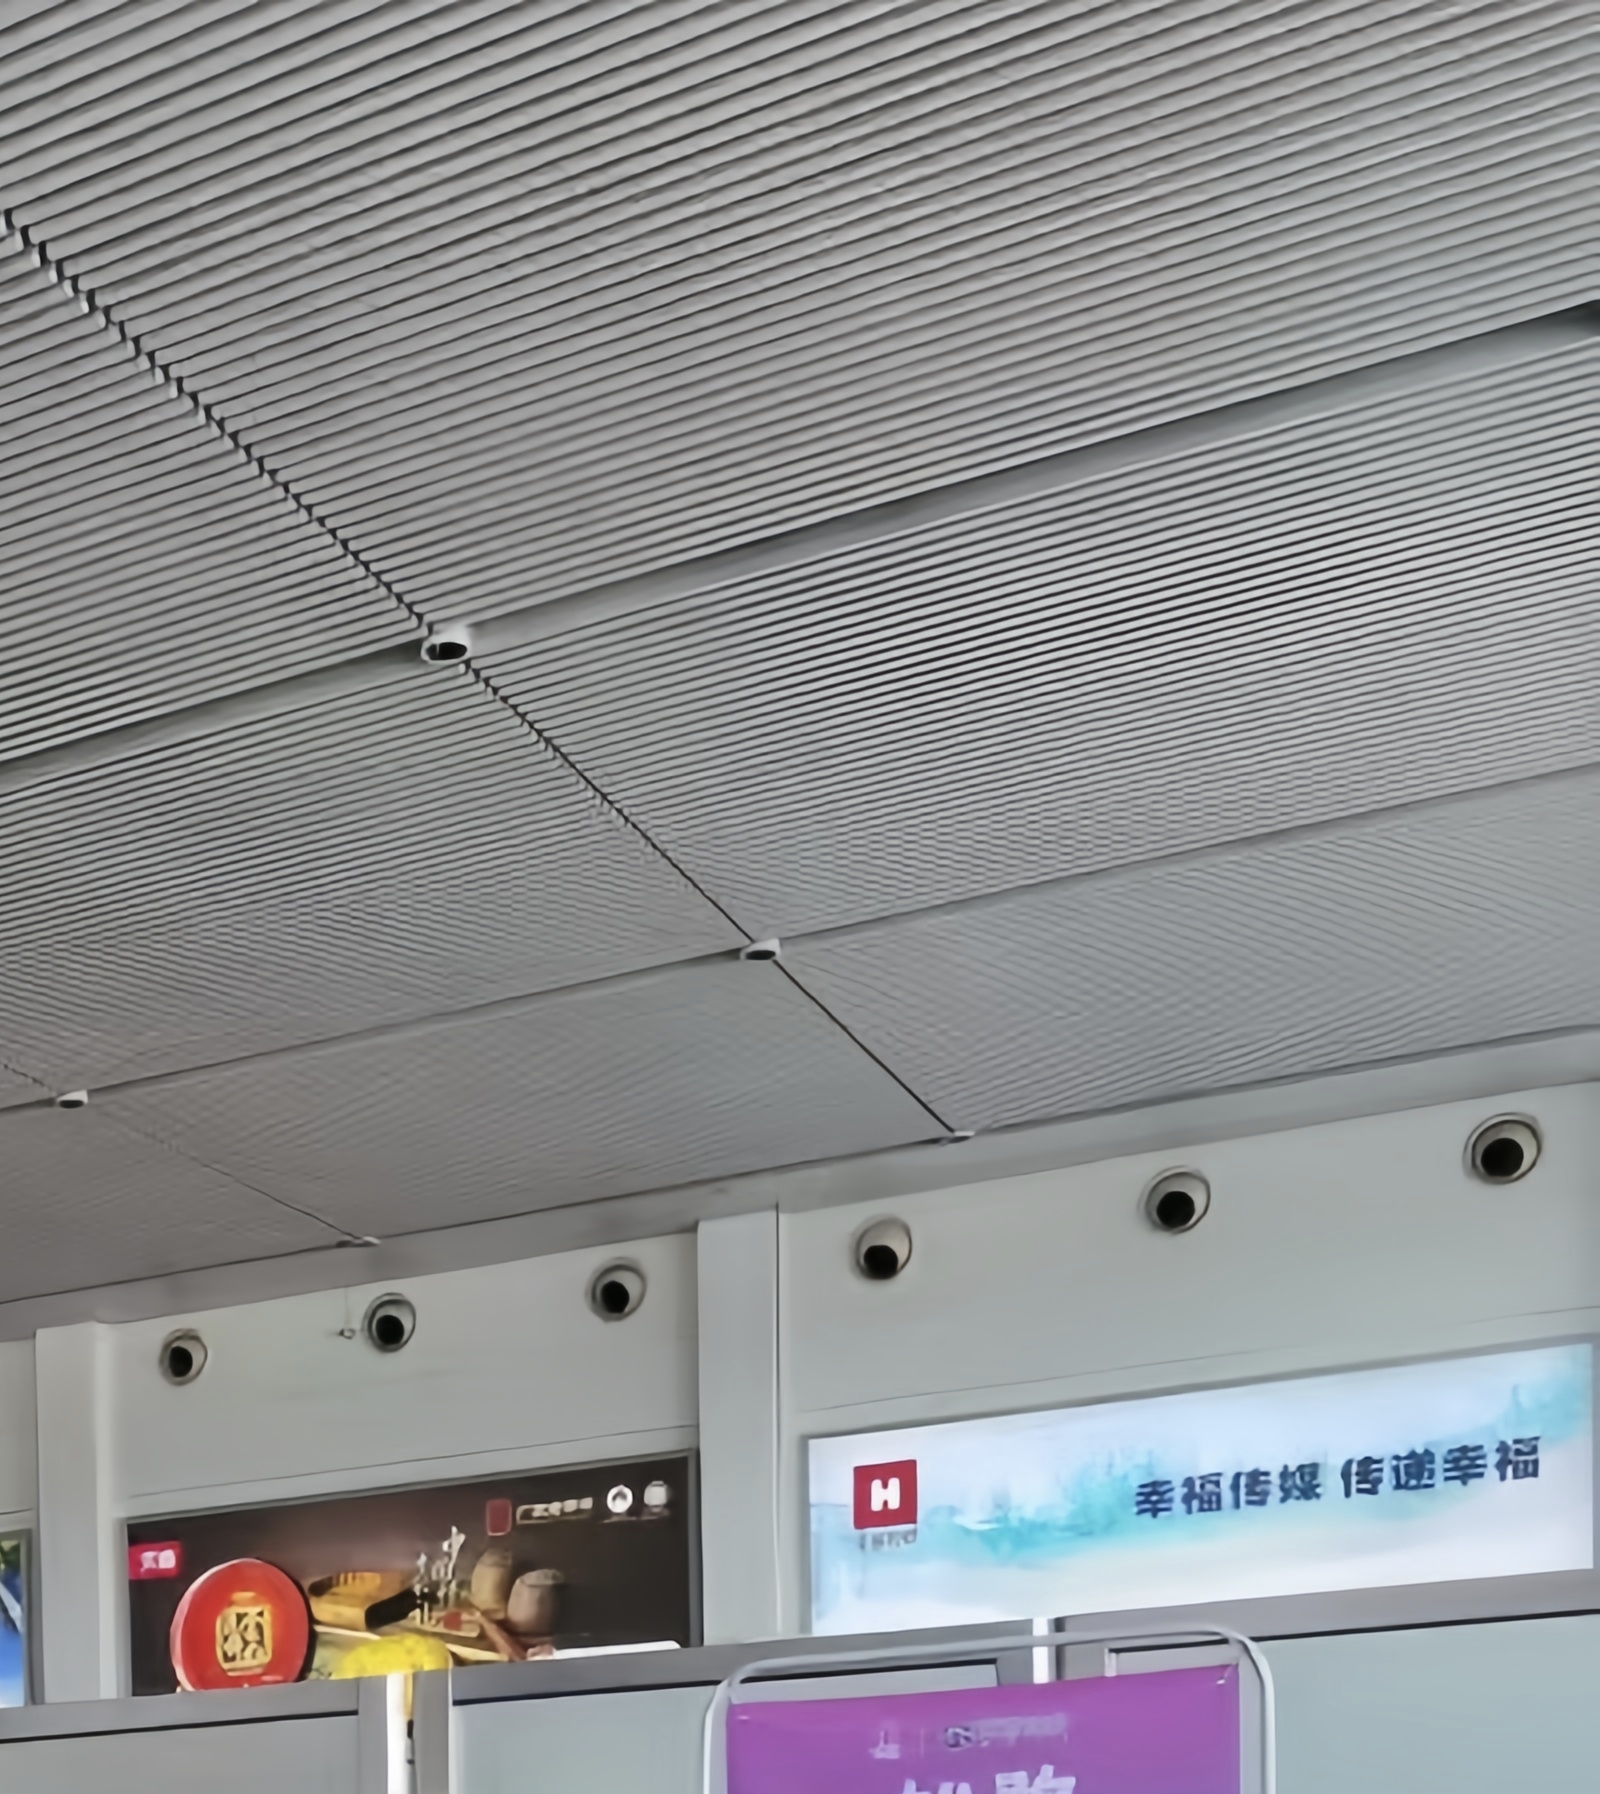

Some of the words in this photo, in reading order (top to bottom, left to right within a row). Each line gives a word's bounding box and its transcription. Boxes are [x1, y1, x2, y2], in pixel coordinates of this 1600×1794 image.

[870, 1477, 901, 1512] H
[1134, 1461, 1323, 1519] 幸福传媒
[1340, 1435, 1542, 1499] 传递幸福
